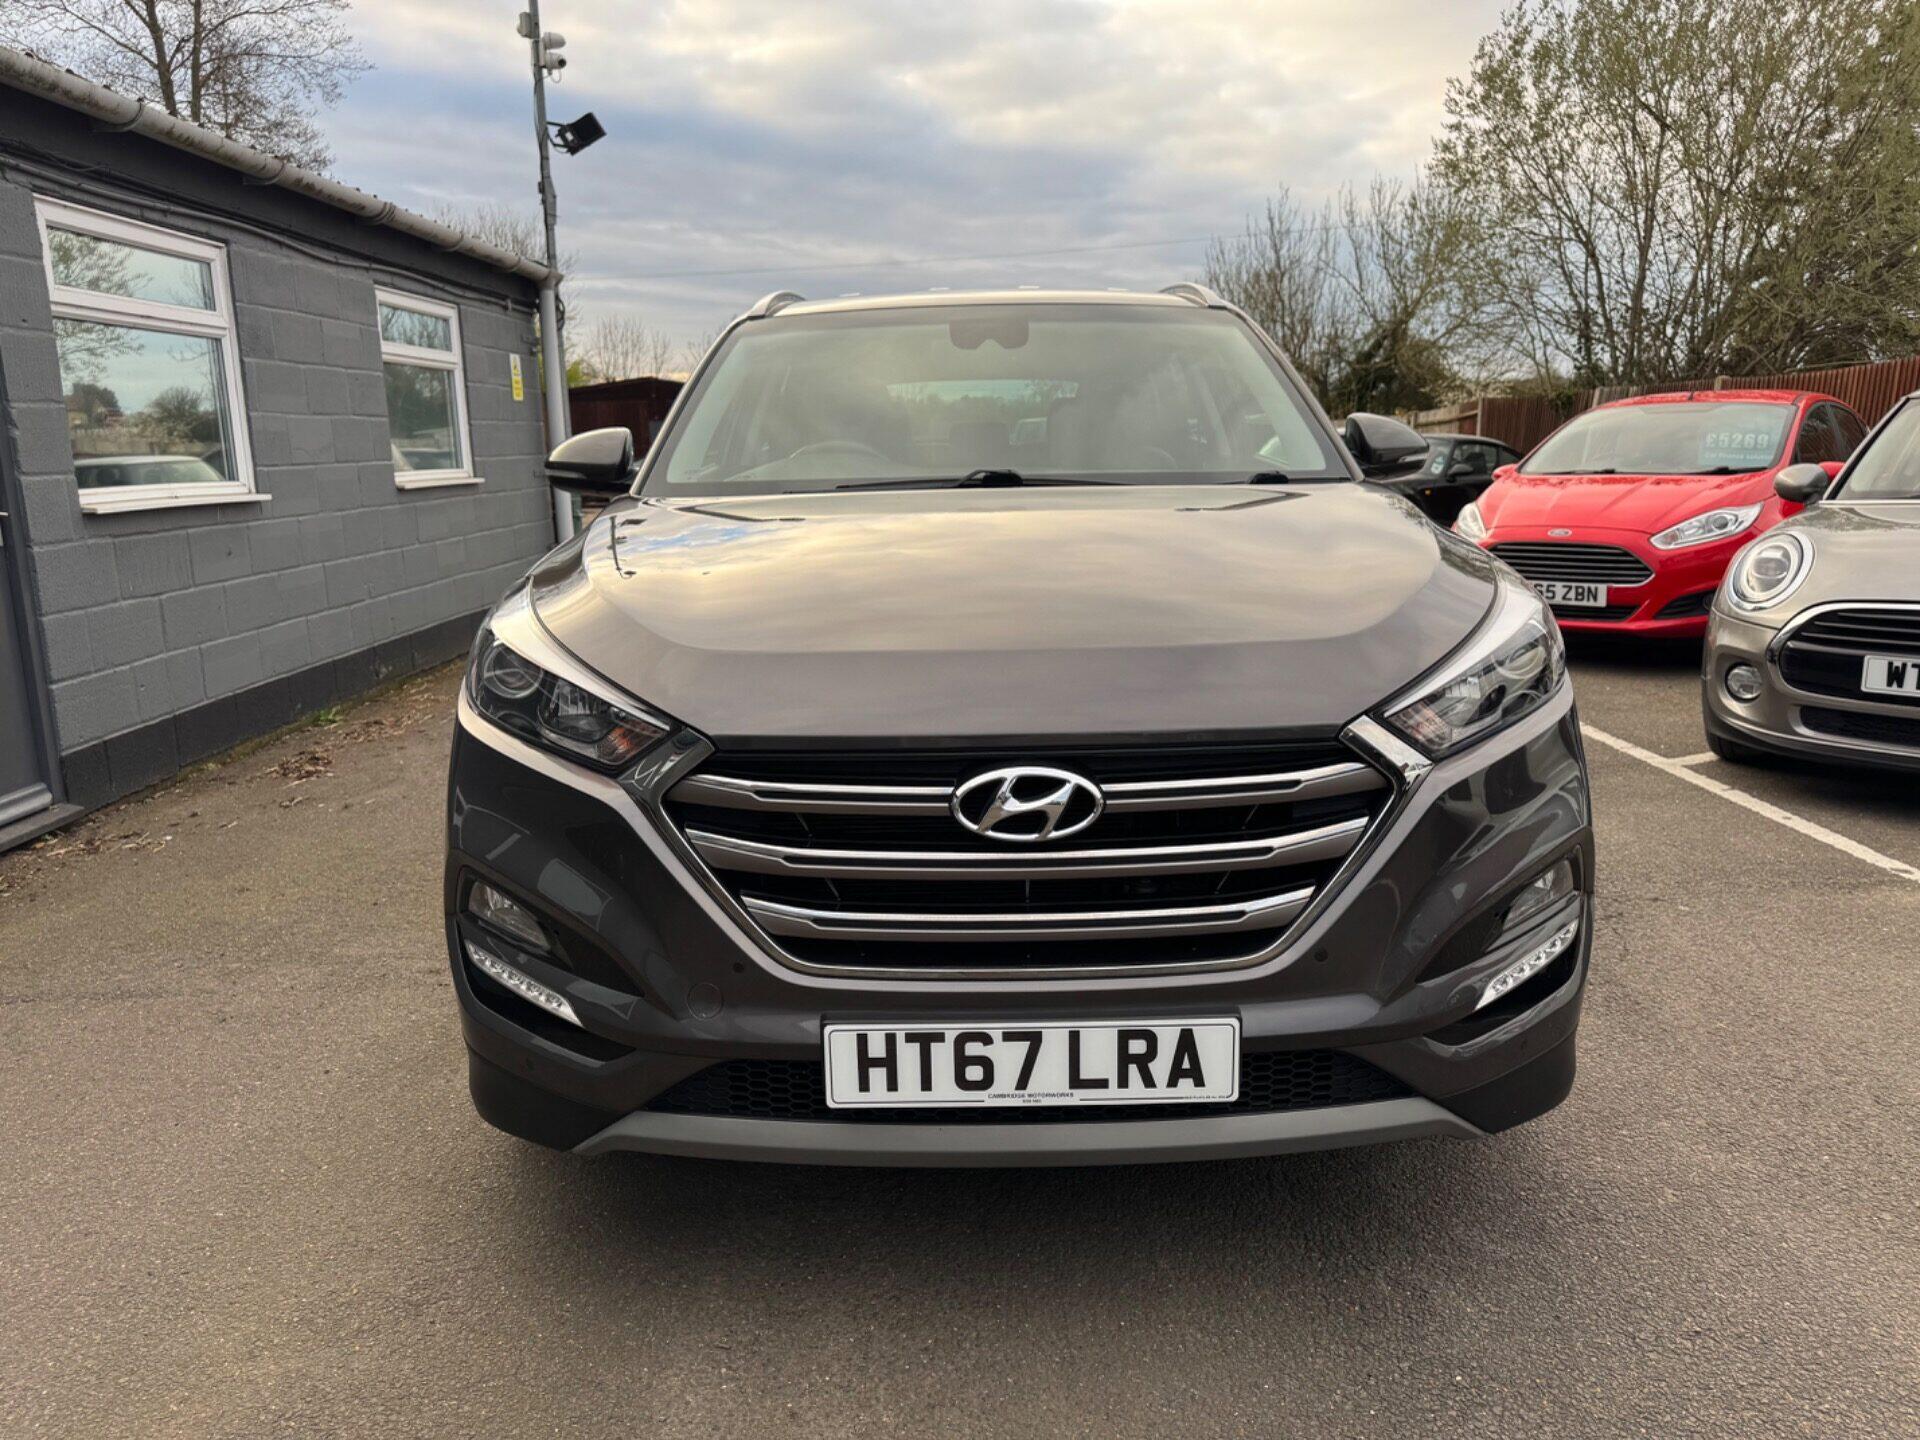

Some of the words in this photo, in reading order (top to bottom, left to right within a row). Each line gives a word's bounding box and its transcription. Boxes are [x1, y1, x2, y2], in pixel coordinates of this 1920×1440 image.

[1561, 585, 1599, 602] ZBN
[856, 1031, 1043, 1093] HT67
[1068, 1028, 1206, 1090] LRA
